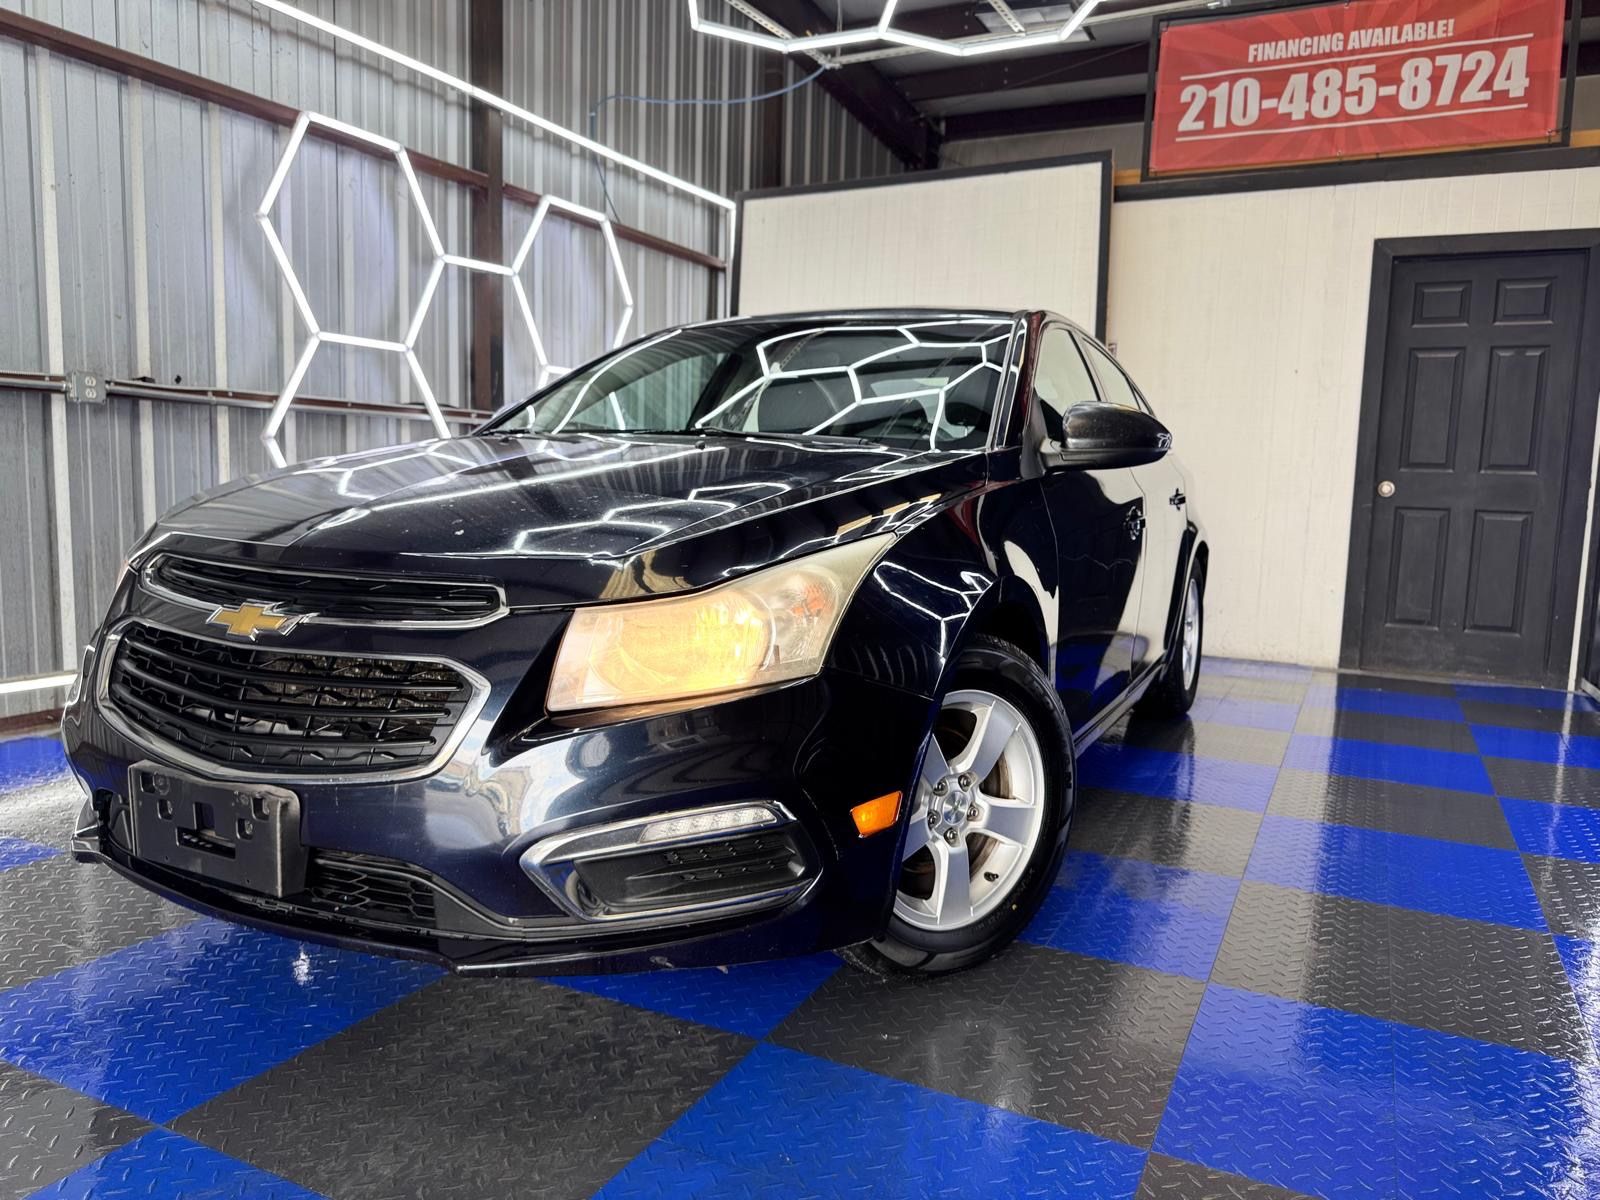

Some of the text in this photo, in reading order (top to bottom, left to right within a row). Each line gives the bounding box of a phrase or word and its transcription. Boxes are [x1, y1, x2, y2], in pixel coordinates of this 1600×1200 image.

[1248, 18, 1455, 63] FINANCING AVAILABLE!
[1177, 45, 1530, 132] 210-485-8724
